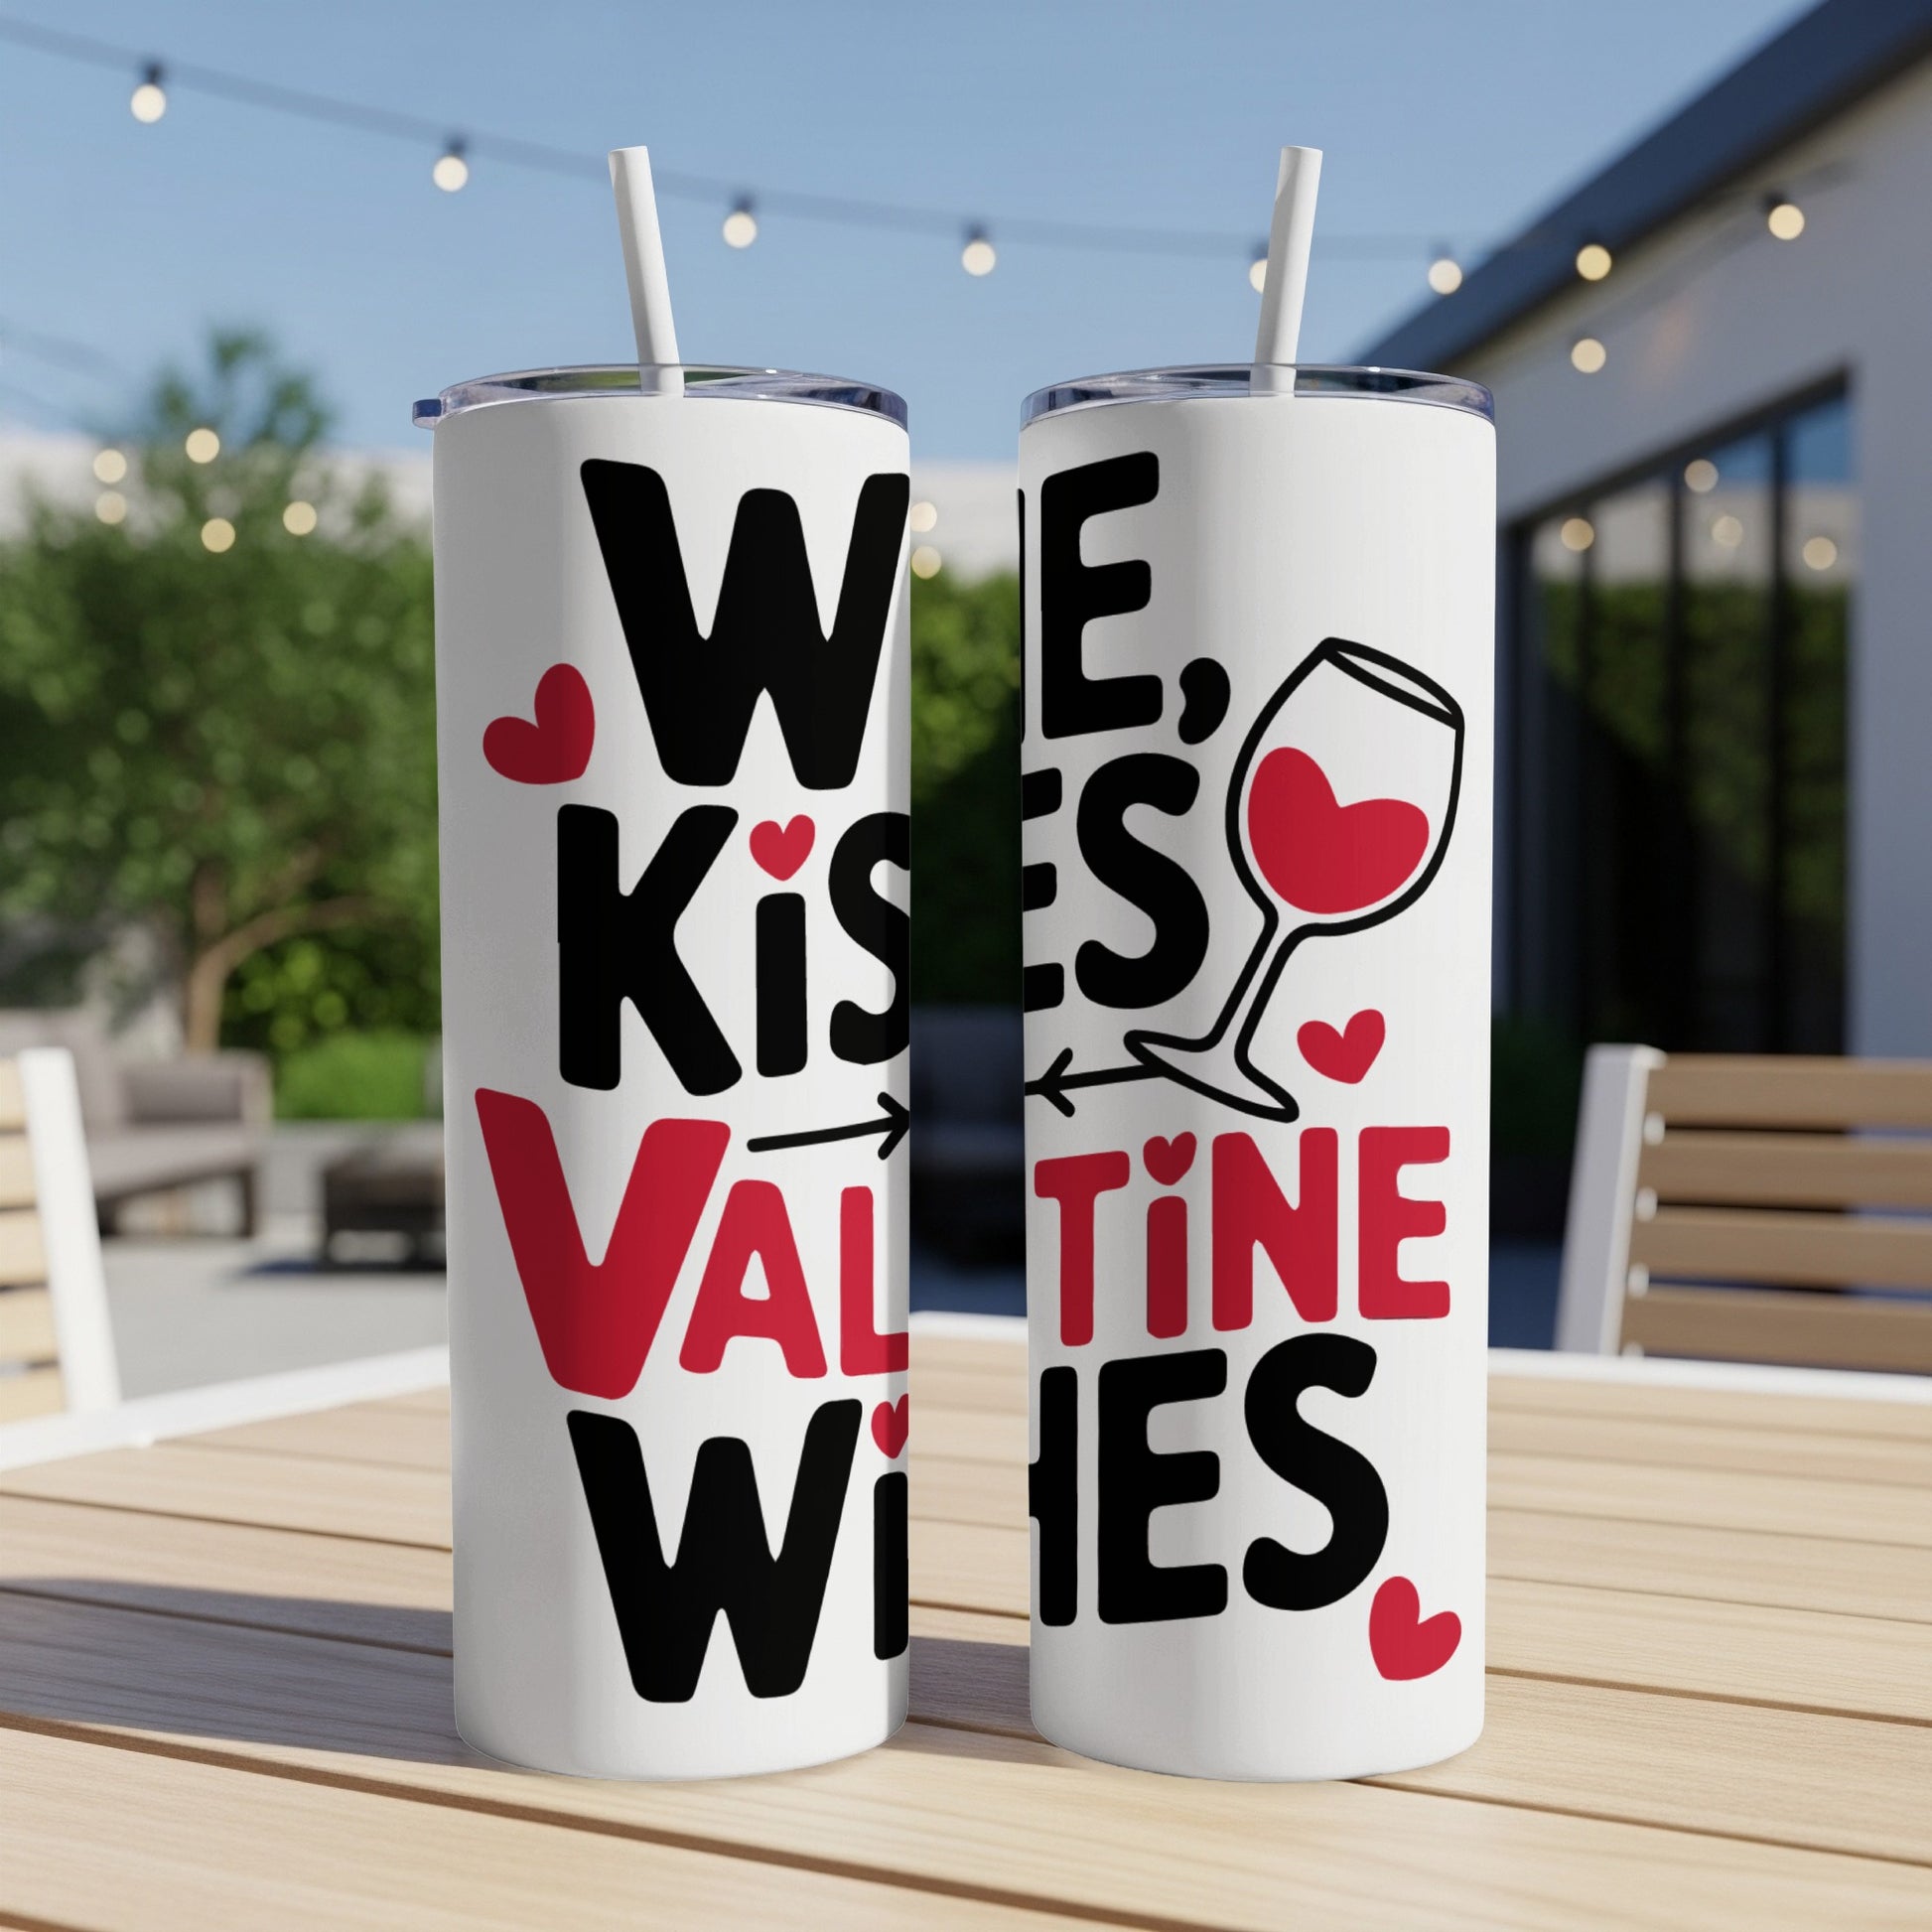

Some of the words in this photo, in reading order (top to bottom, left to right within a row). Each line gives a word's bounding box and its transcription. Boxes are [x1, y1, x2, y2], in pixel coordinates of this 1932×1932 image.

[580, 459, 910, 790] W
[1019, 451, 1231, 745] E,
[475, 1087, 909, 1400] VAL
